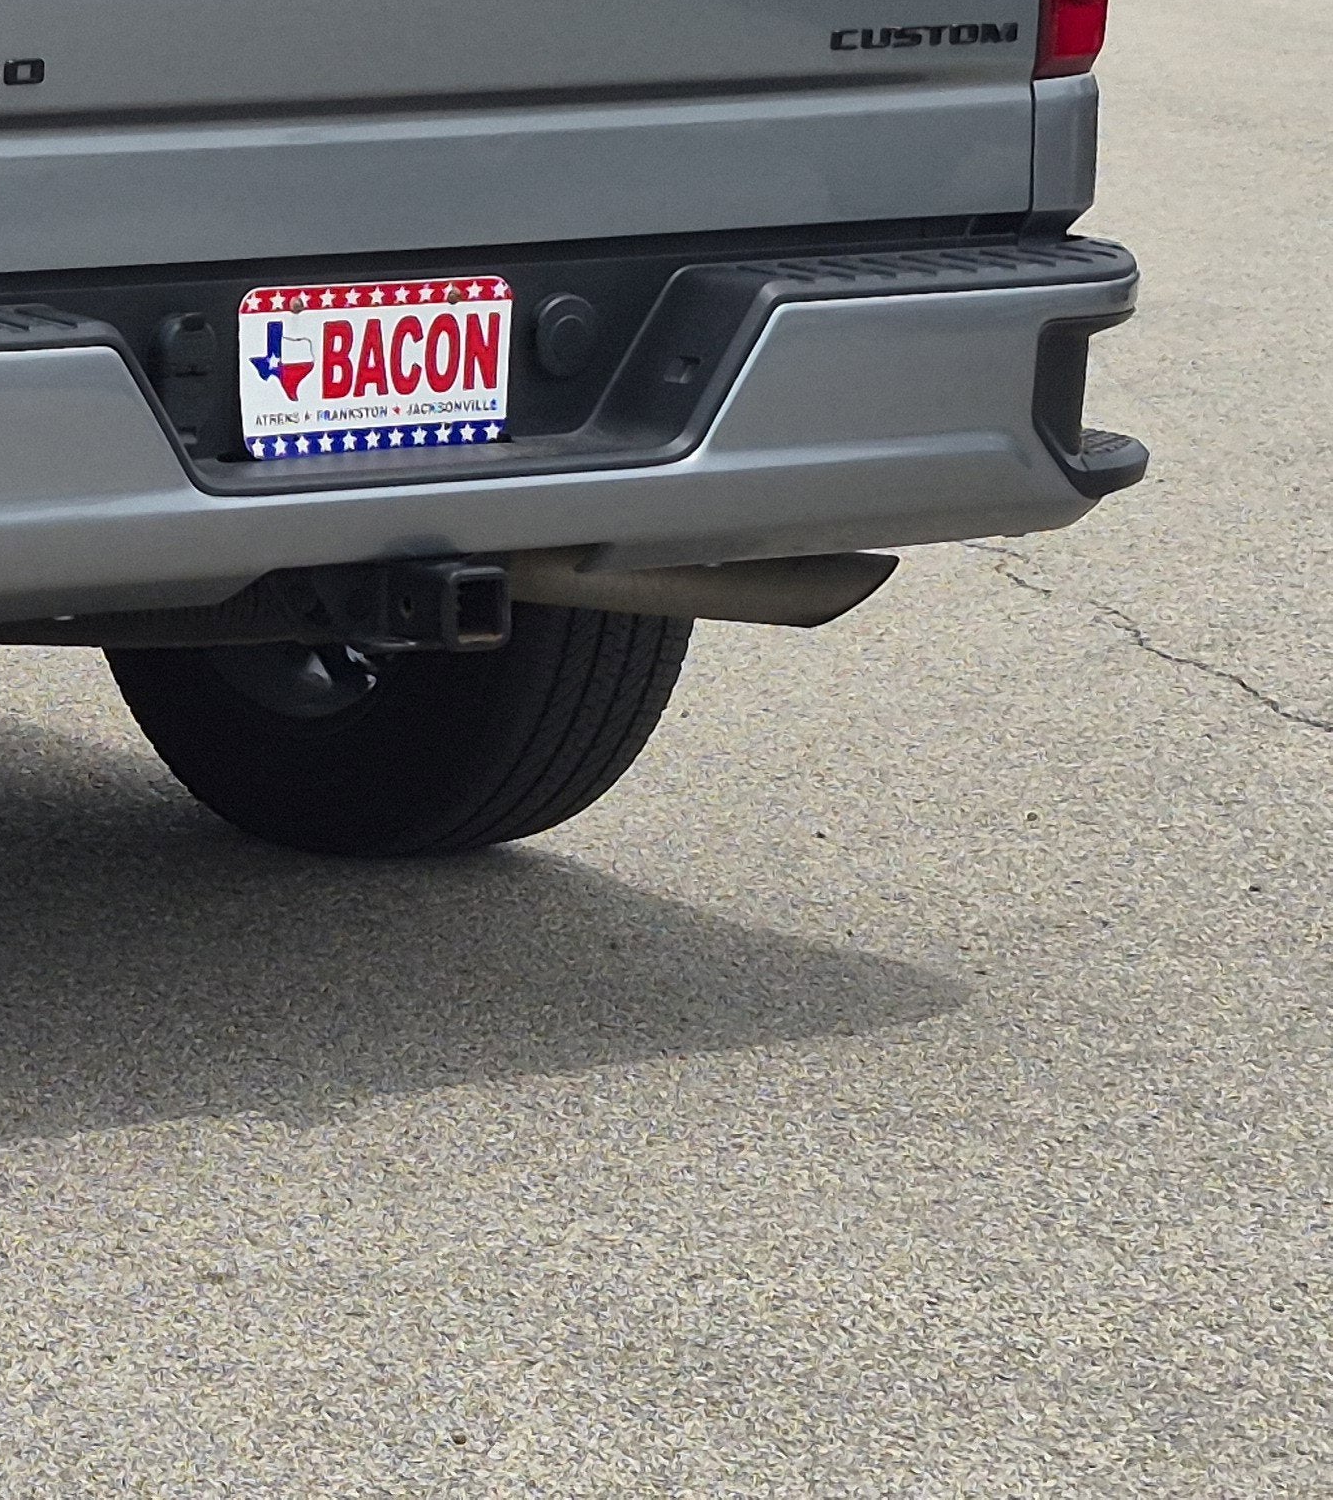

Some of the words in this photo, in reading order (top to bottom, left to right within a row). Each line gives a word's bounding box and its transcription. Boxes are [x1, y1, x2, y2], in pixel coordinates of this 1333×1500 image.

[830, 22, 1019, 50] CUSTOM
[322, 312, 501, 399] BACON
[255, 411, 300, 426] ATHENS
[317, 405, 388, 422] FRANKSTON
[406, 398, 498, 416] JACKSONVILLE
